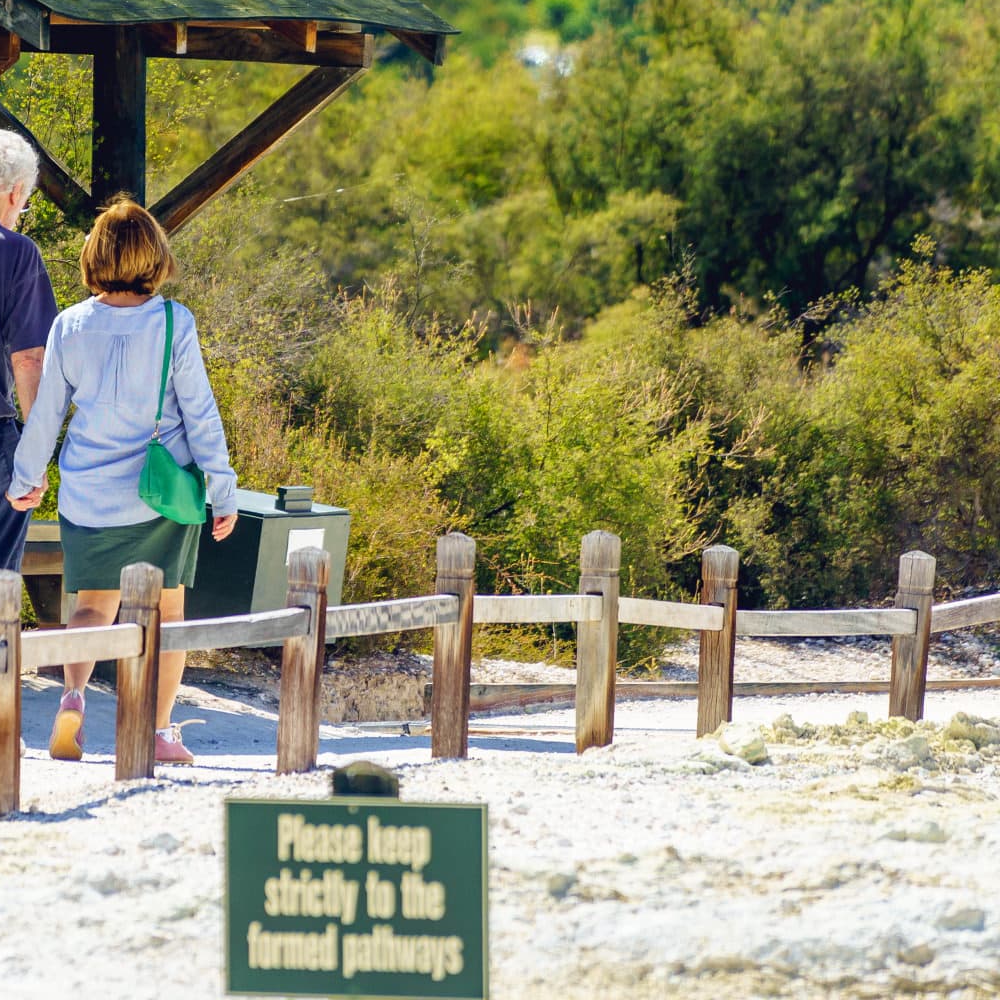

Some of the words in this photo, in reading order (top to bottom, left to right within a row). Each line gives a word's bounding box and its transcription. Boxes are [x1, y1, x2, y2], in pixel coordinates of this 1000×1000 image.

[278, 814, 362, 863] Please
[367, 816, 431, 871] keep
[264, 868, 359, 925] strictly
[366, 871, 395, 918] to
[401, 872, 446, 920] the
[247, 921, 338, 970] formed
[342, 925, 463, 981] pathways
